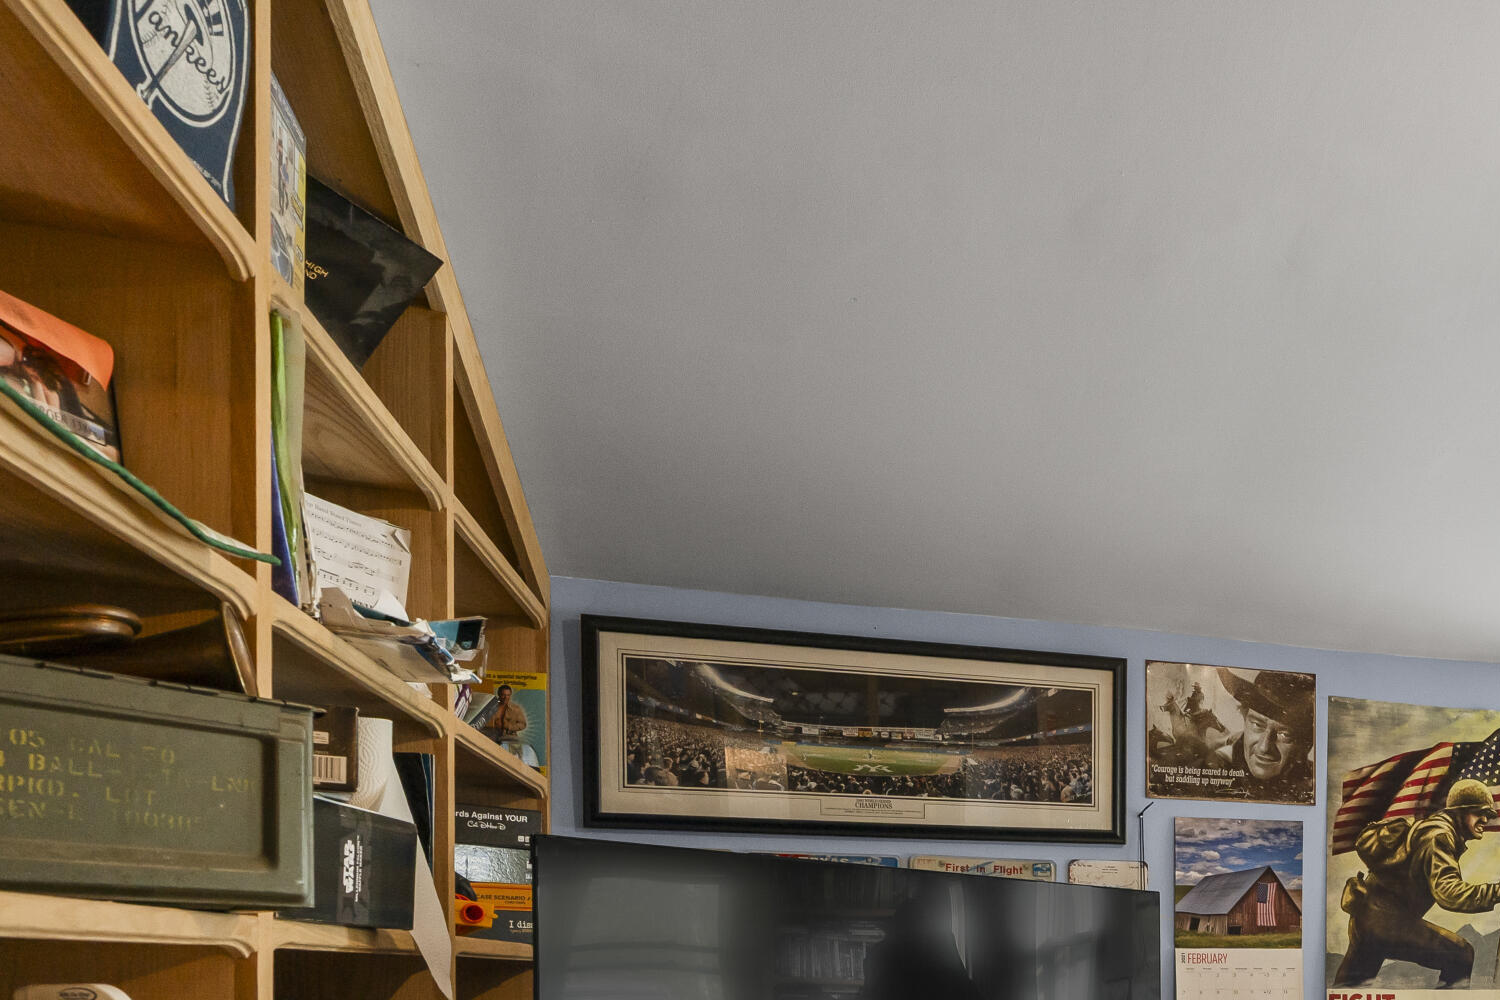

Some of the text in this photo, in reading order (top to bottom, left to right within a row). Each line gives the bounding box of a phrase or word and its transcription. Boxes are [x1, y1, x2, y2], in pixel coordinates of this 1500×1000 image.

[455, 810, 528, 823] rds Against YOUR
[945, 863, 970, 873] First
[993, 864, 1024, 875] Flight
[1187, 952, 1228, 964] FEBRUARY
